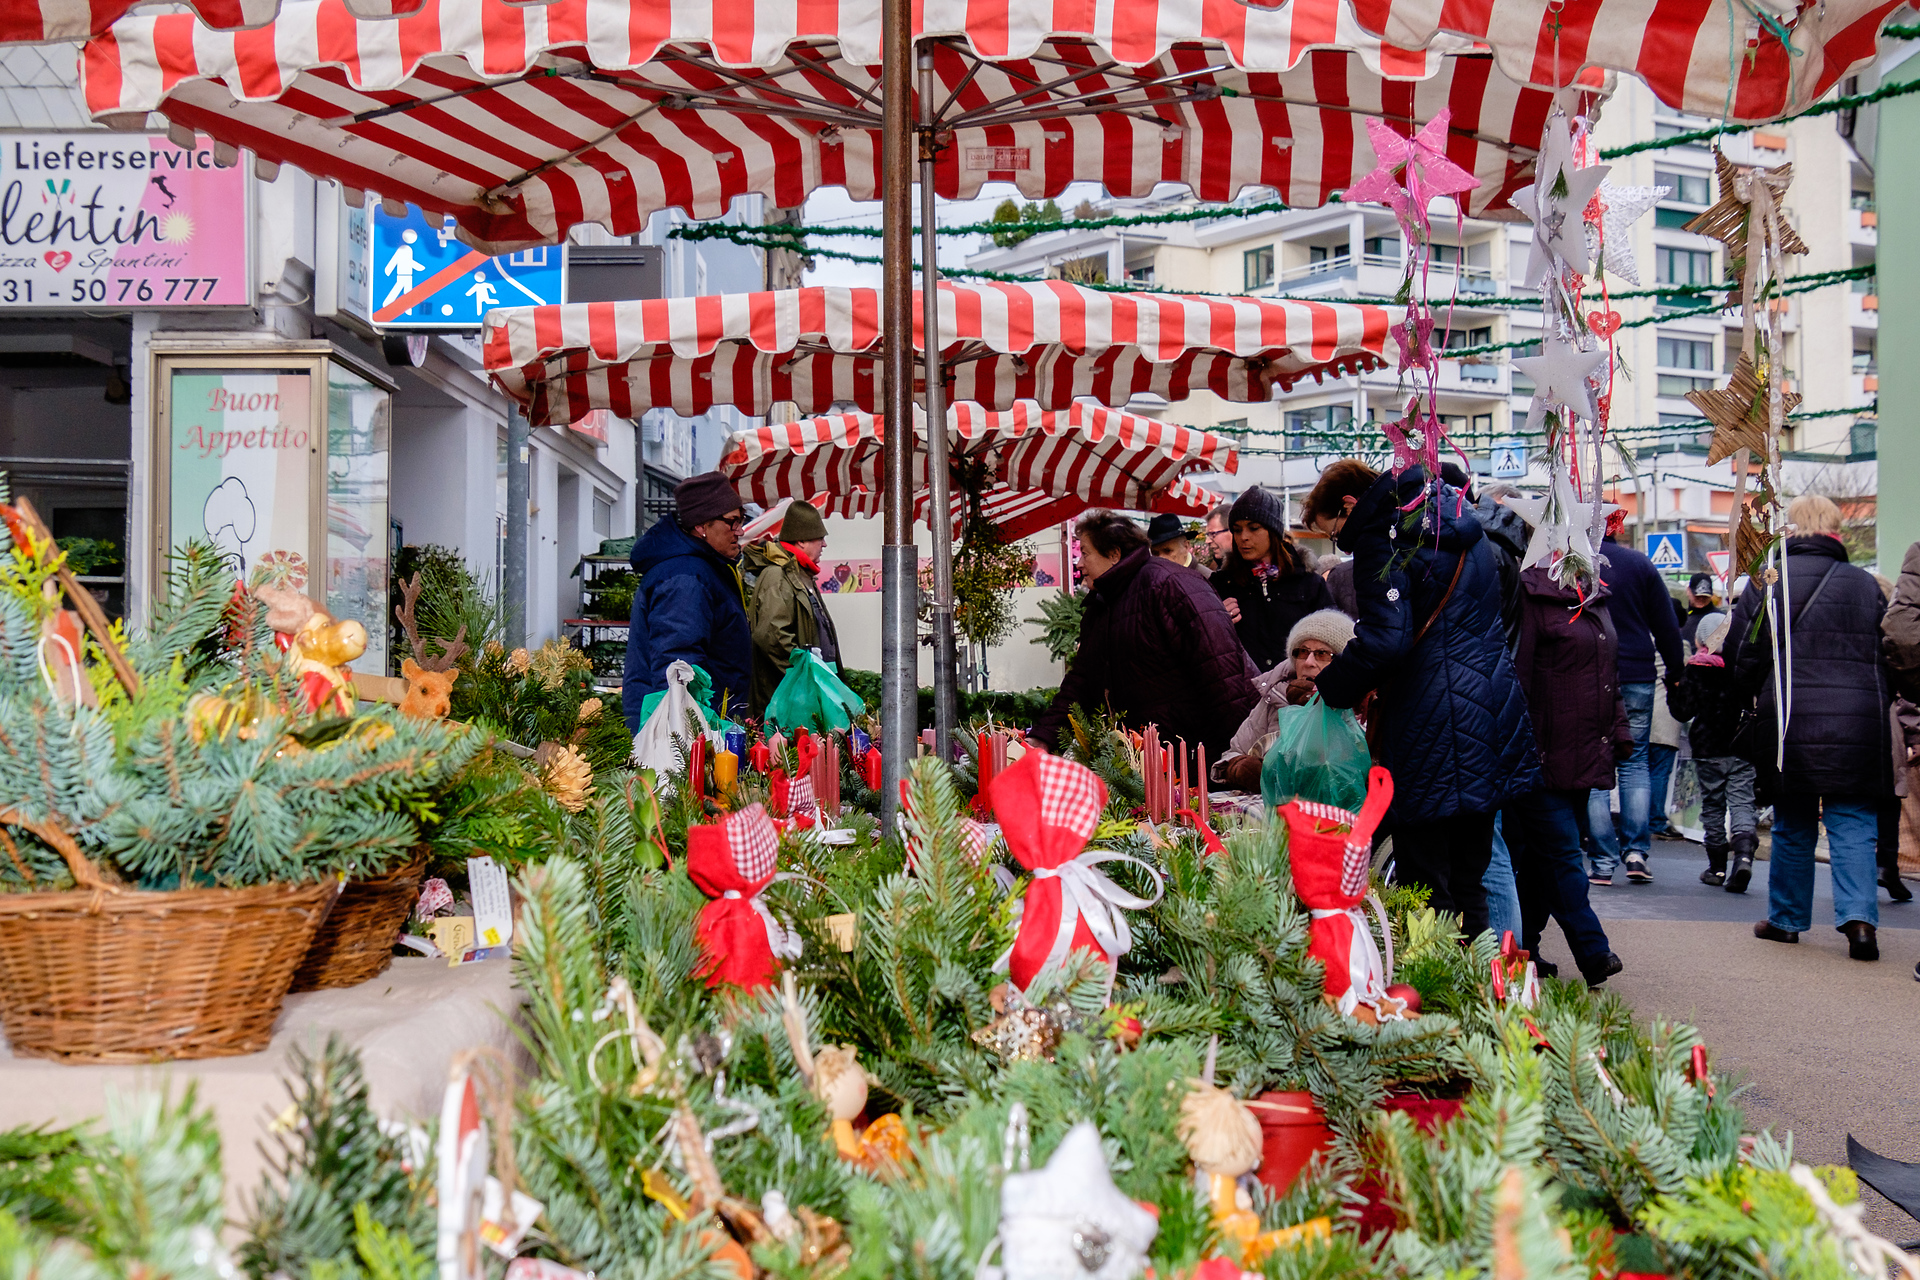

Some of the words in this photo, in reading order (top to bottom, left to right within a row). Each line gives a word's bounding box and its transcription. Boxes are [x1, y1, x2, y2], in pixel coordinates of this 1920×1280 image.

[15, 141, 229, 170] Lieferservic
[0, 180, 167, 245] lentin
[79, 249, 188, 275] Spuntini
[2, 279, 33, 302] 31
[72, 278, 107, 302] 50
[117, 278, 153, 302] 76
[165, 277, 219, 302] 777
[208, 387, 281, 413] Buon
[180, 424, 308, 459] Appetito
